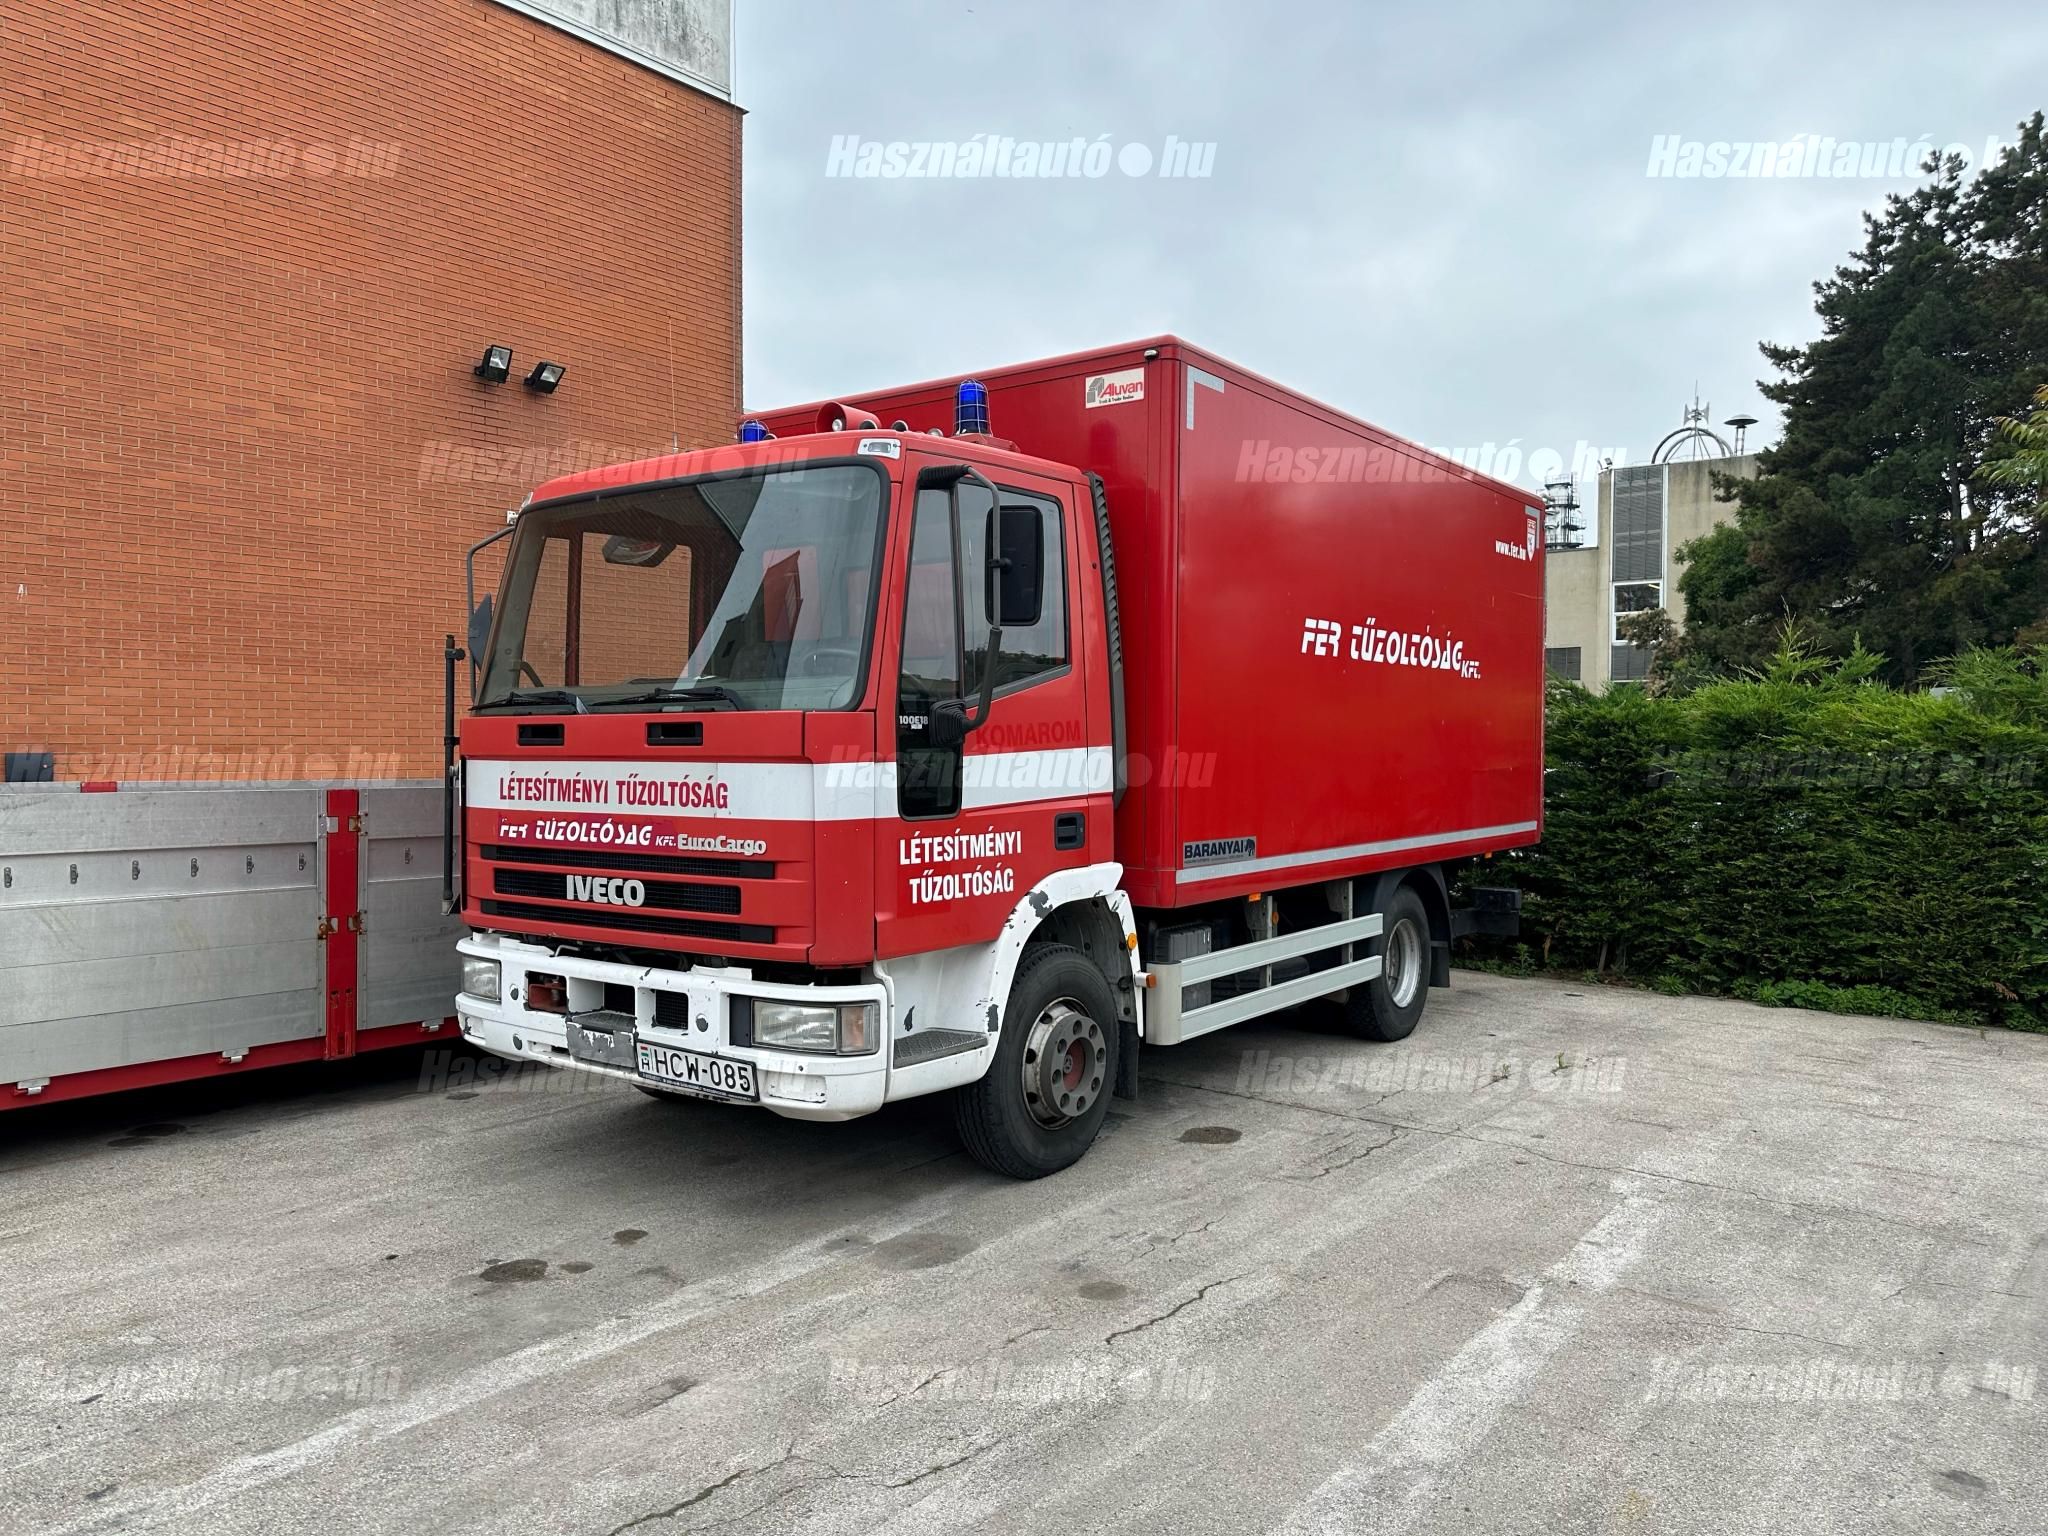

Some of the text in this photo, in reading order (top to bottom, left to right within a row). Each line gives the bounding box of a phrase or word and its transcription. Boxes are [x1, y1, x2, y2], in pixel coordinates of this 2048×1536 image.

[1100, 381, 1143, 399] Aluvan
[1301, 618, 1342, 657] FER
[500, 771, 729, 810] LÉTESÍTMÉNYI TŰZOLTÓSÁG
[677, 833, 767, 856] EuroCargo
[900, 826, 1022, 865] LÉTESÍTMÉNYI
[1184, 840, 1244, 859] BARANYAI
[566, 874, 645, 907] IVECO
[910, 863, 1014, 904] TŰZOLTÓSÁG
[654, 1049, 751, 1092] HCW-085
